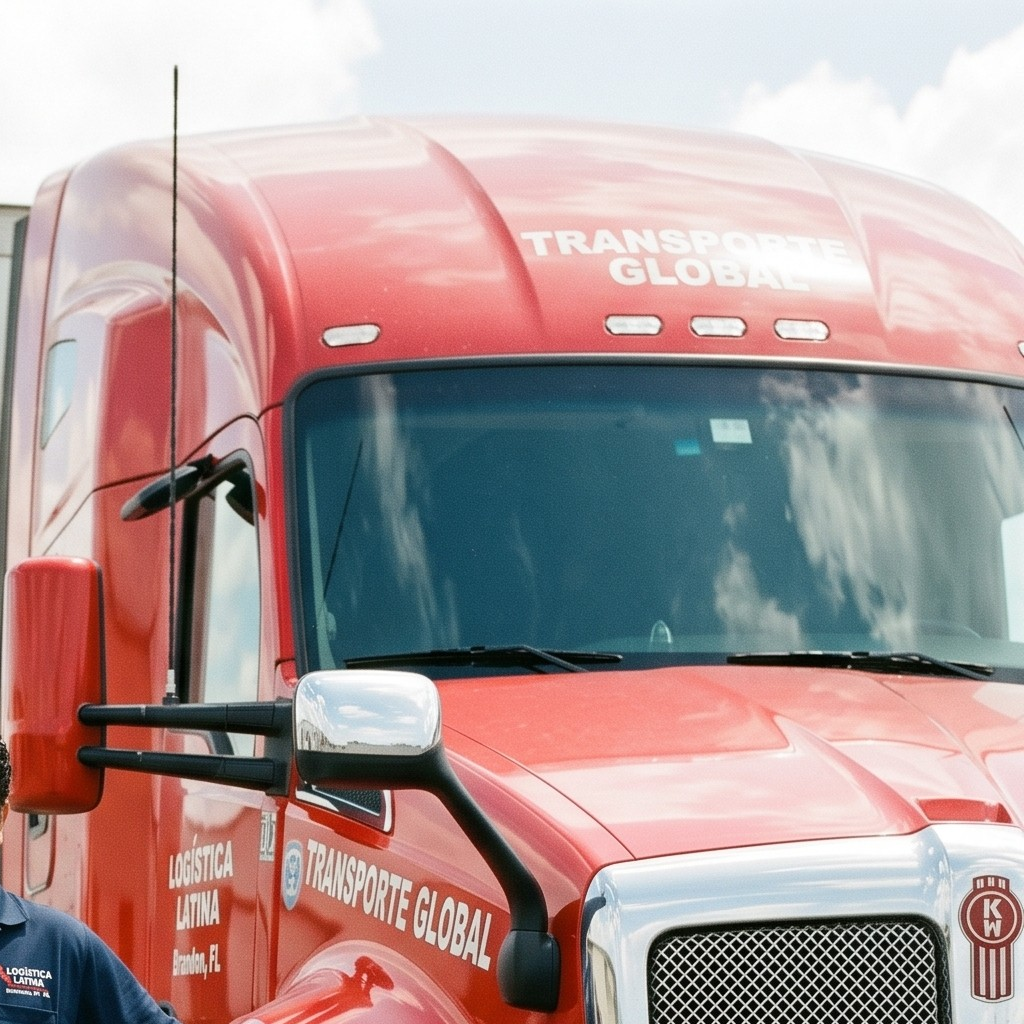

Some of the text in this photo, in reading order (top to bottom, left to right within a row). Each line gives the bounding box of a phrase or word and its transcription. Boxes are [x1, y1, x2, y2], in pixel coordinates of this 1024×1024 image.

[521, 228, 854, 265] TRANSPORTE
[608, 256, 811, 292] GLOBAL
[168, 832, 234, 890] LOGÍSTICA
[176, 888, 221, 931] LATINA
[304, 838, 492, 972] TRANSPORTE GLOBAL
[172, 943, 221, 981] Brandon, FL
